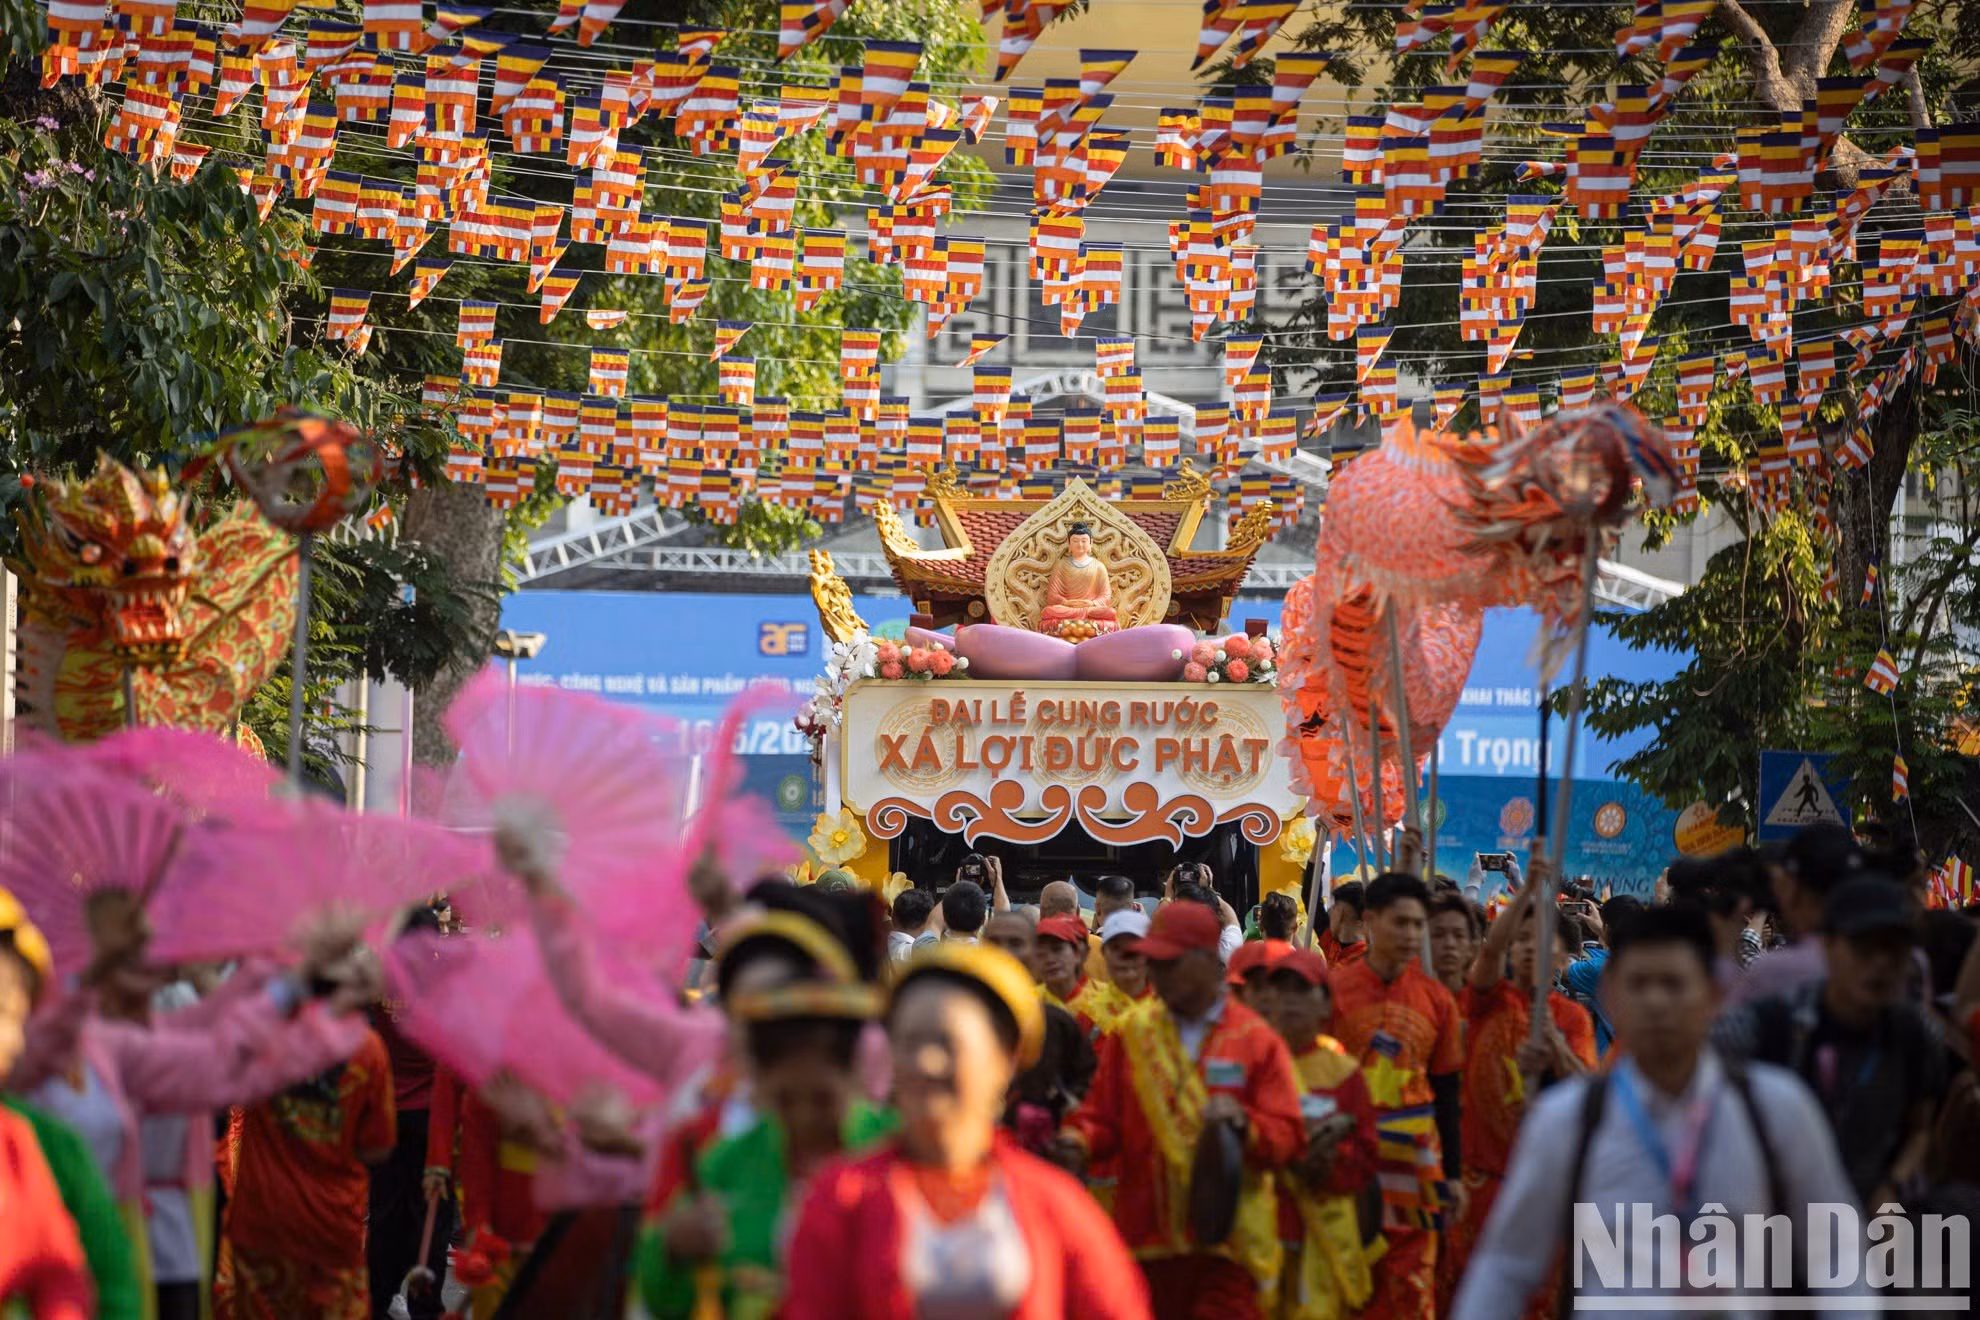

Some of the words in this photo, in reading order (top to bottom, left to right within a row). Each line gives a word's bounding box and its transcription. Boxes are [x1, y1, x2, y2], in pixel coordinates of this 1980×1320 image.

[991, 691, 1027, 724] LỄ
[1036, 699, 1121, 726] CUNG
[1130, 695, 1219, 727] RƯỚC
[880, 725, 943, 770] XÁ
[956, 734, 1035, 779] LỢI
[1043, 727, 1140, 772] ĐỨC
[1155, 733, 1269, 783] PHẬT
